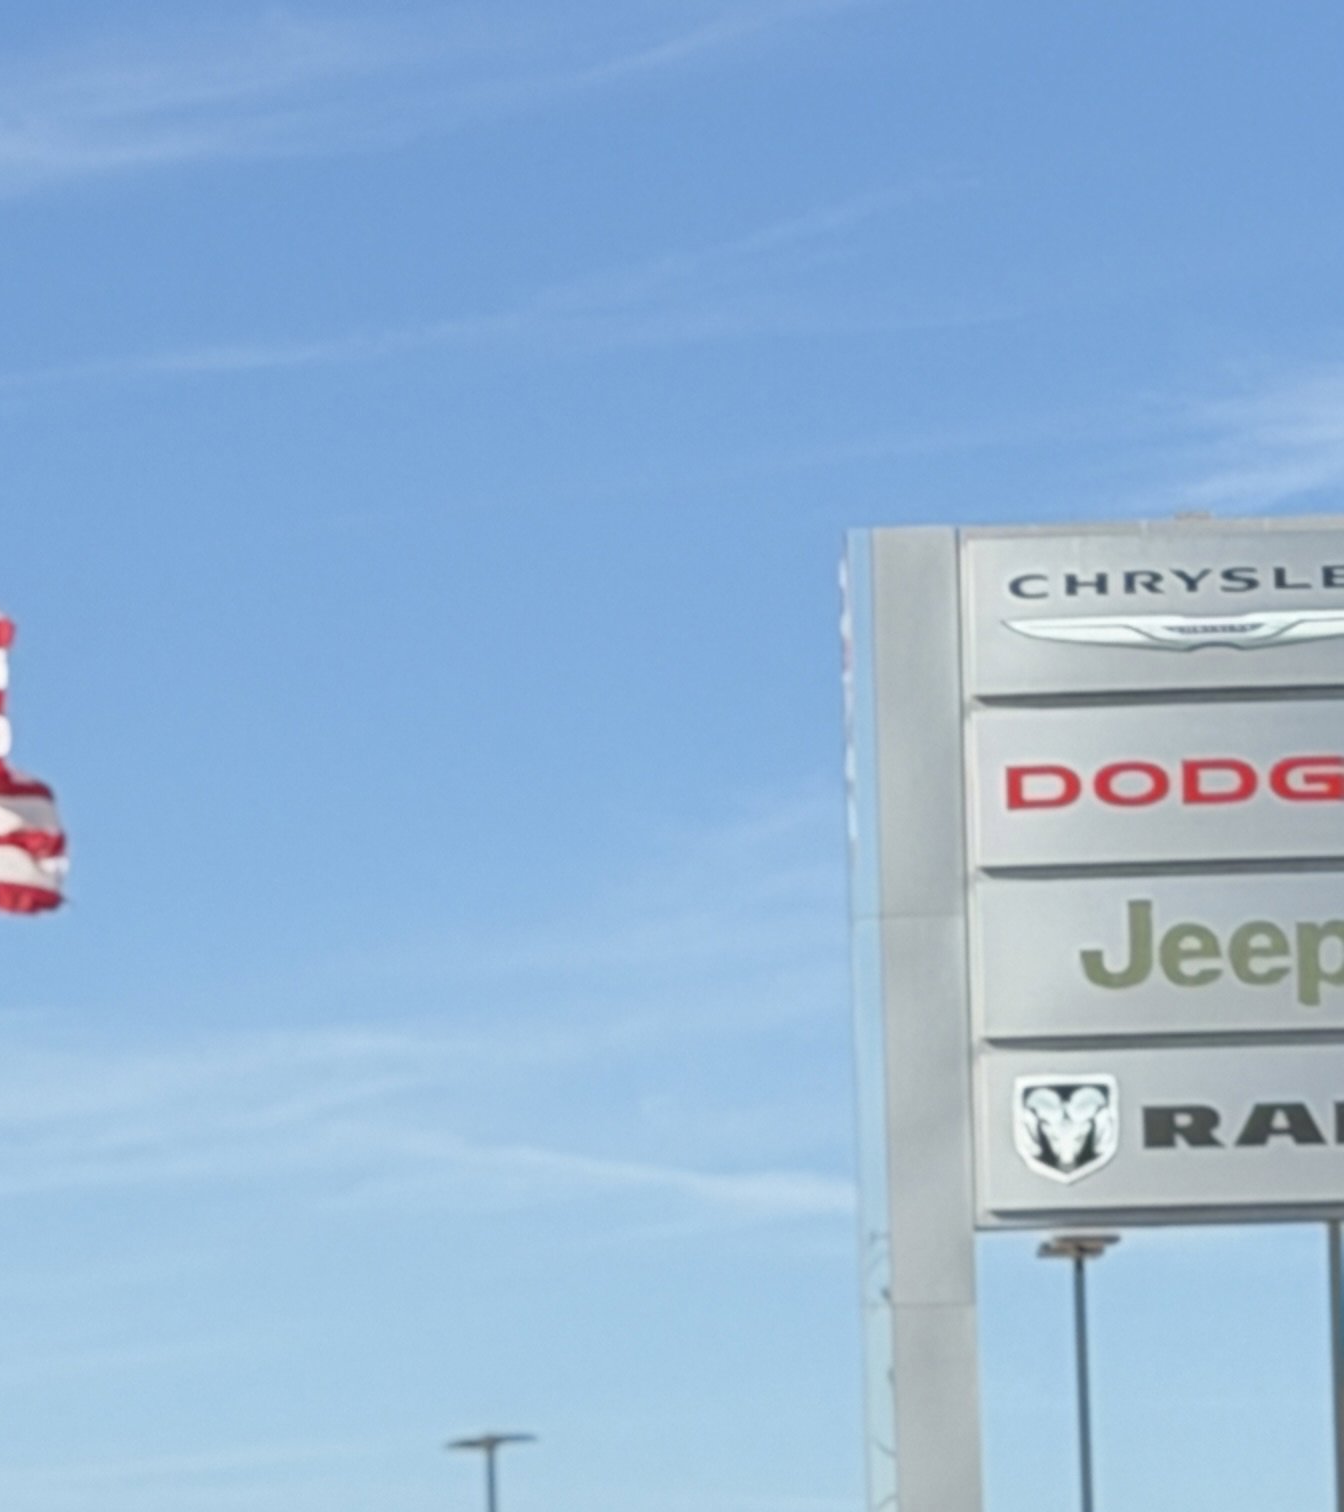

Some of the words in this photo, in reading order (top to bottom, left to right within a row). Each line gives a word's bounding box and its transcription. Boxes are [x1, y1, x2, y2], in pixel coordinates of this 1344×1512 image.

[1005, 756, 1344, 810] DODG
[1079, 900, 1344, 1006] Jeep
[1142, 1101, 1344, 1149] RA
